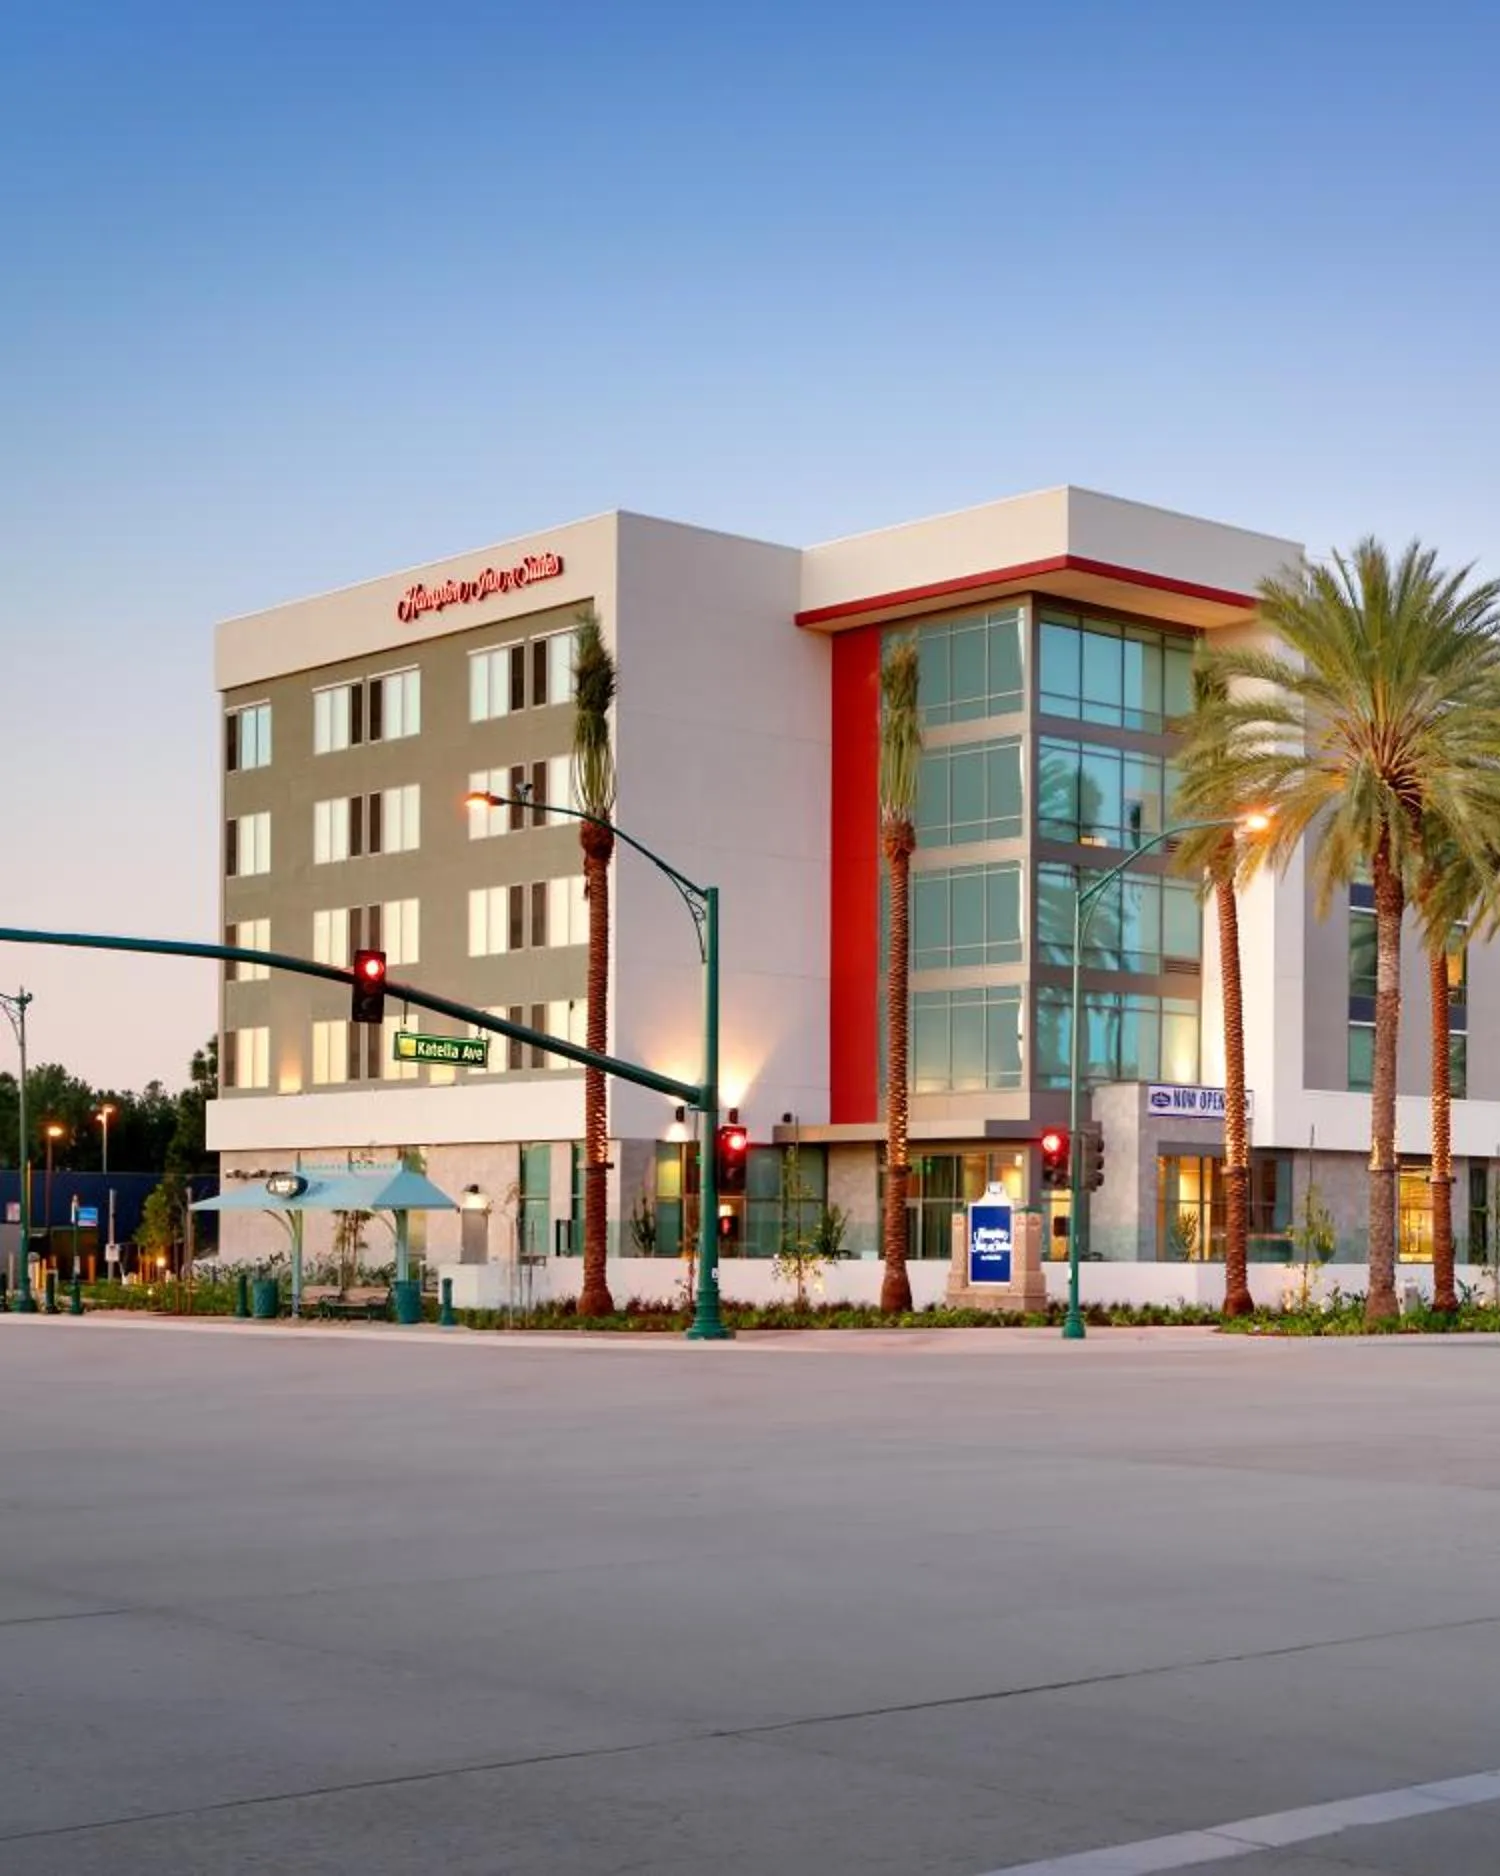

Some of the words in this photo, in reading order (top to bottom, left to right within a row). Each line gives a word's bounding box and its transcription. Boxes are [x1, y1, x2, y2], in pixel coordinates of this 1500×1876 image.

[397, 579, 473, 623] Hampton
[514, 552, 563, 588] Suites
[417, 1041, 459, 1059] Katella
[462, 1045, 483, 1061] Ave
[1173, 1089, 1197, 1109] NOW
